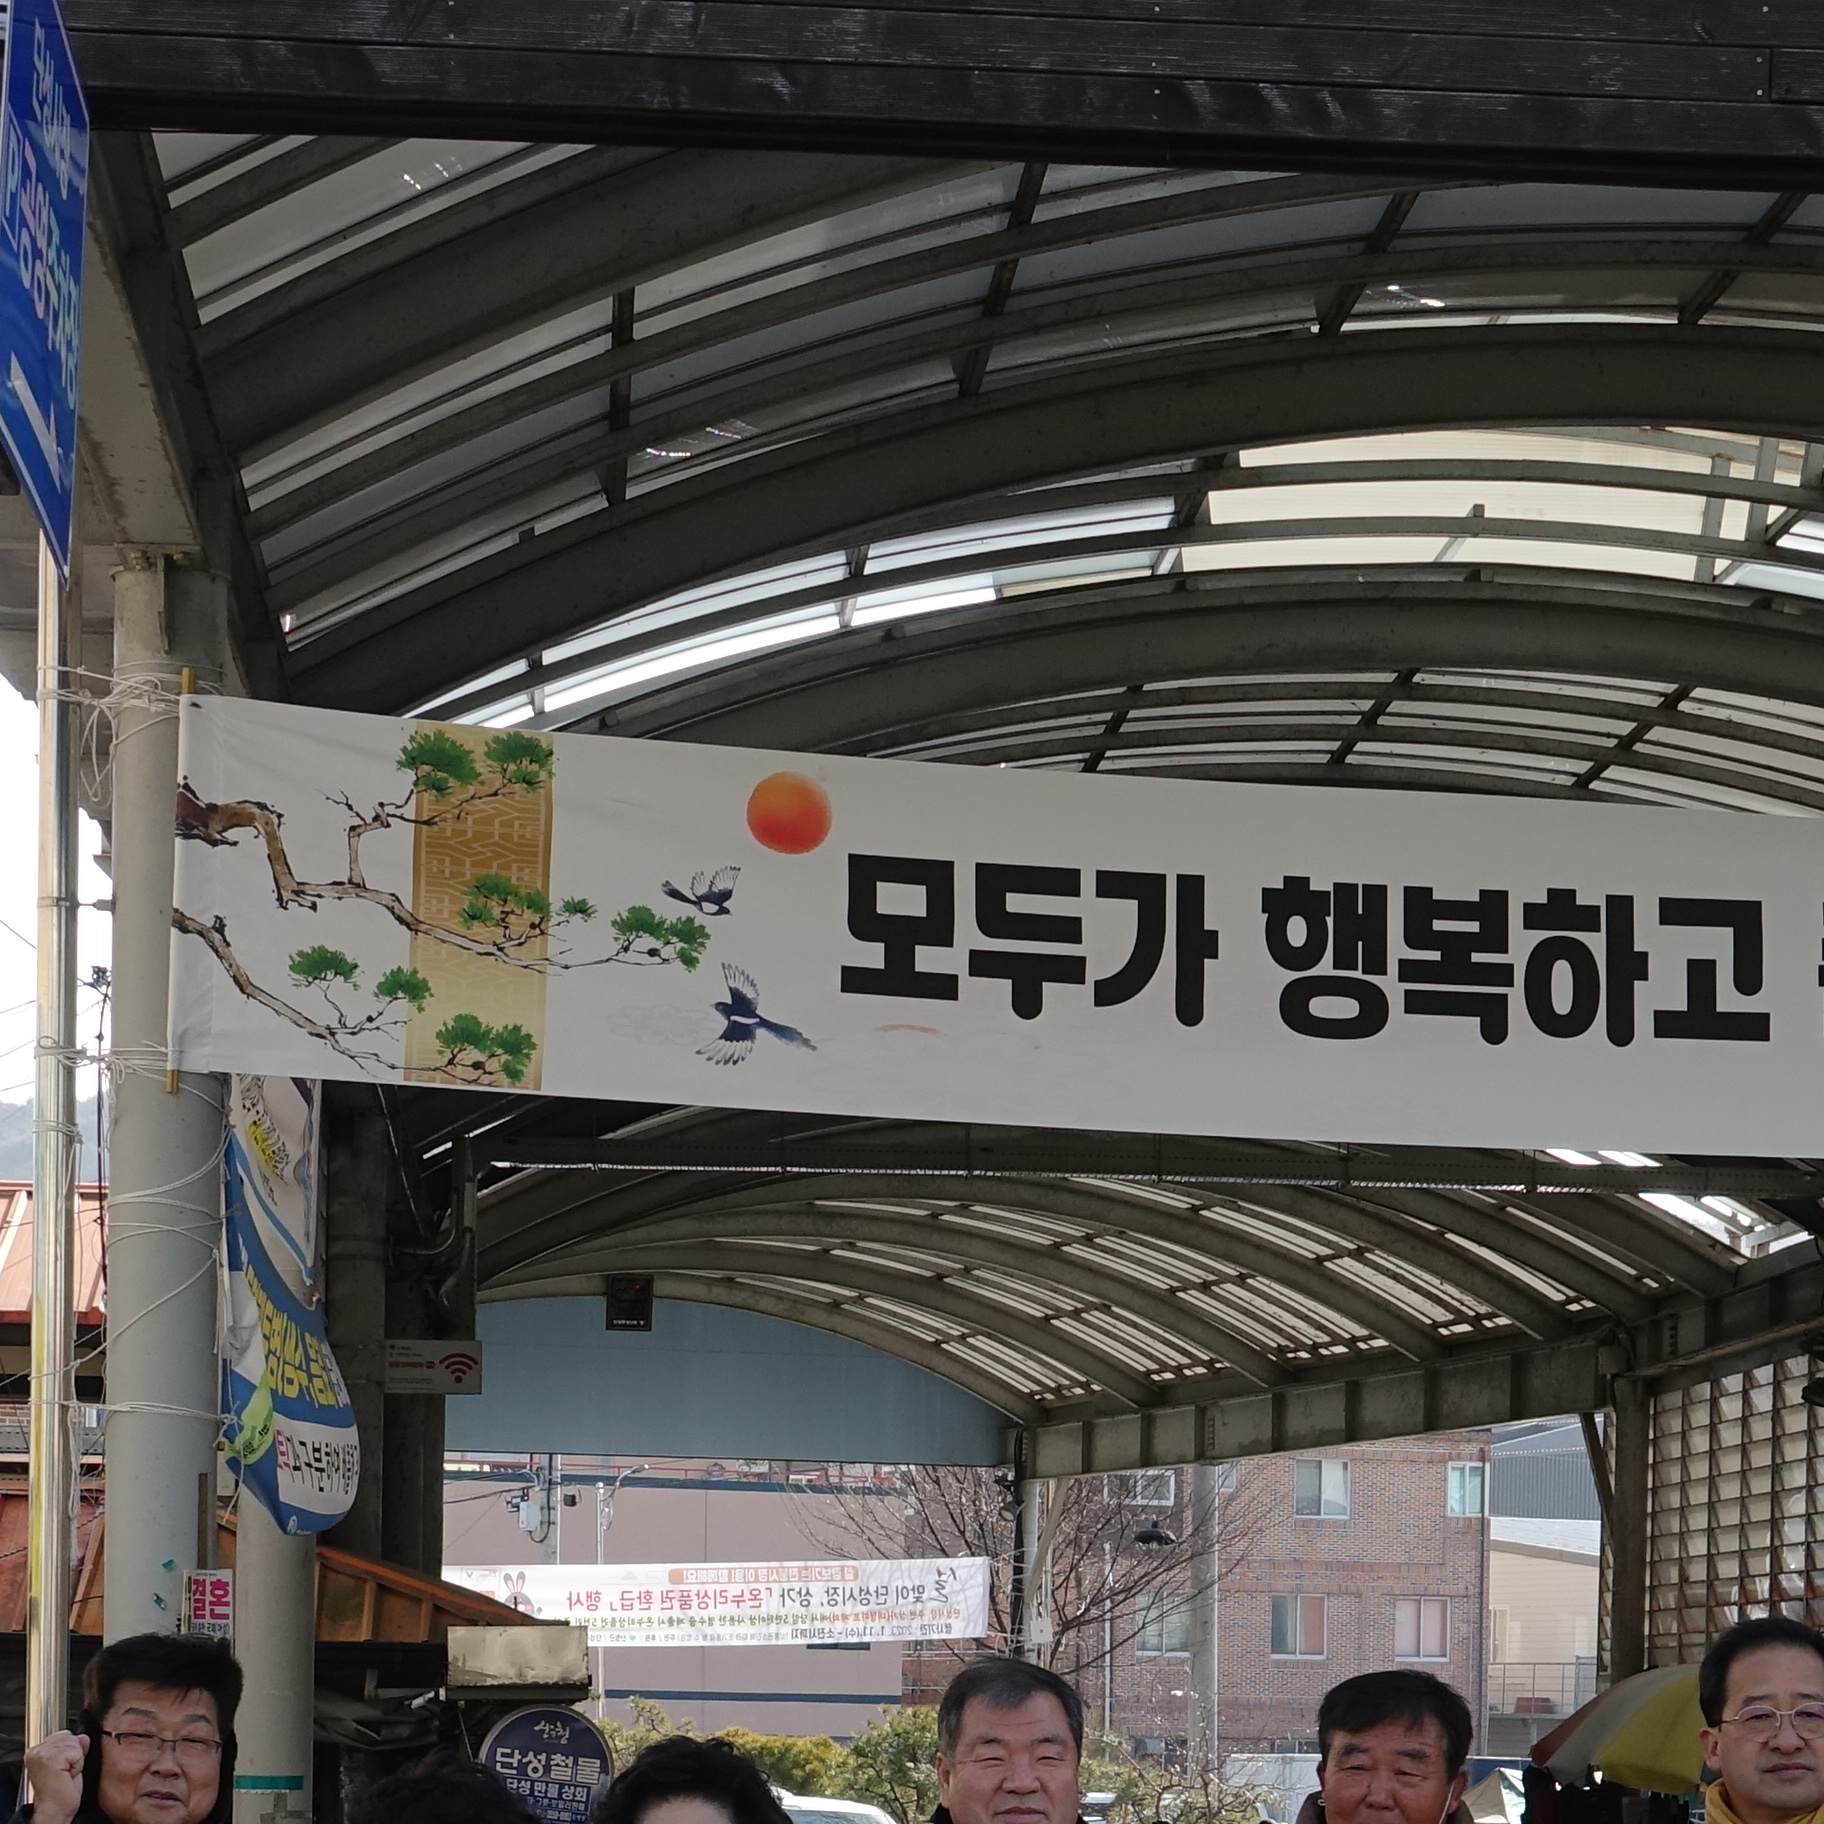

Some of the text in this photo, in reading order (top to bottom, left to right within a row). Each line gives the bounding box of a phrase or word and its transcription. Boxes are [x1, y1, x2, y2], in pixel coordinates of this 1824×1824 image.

[5, 122, 19, 218] P
[33, 16, 71, 201] 단성시장
[19, 138, 80, 411] 공영주차장
[840, 851, 1219, 1027] 모두가
[1262, 873, 1771, 1049] 행복하고
[496, 1747, 601, 1785] 단성철물
[562, 1784, 588, 1801] 상회
